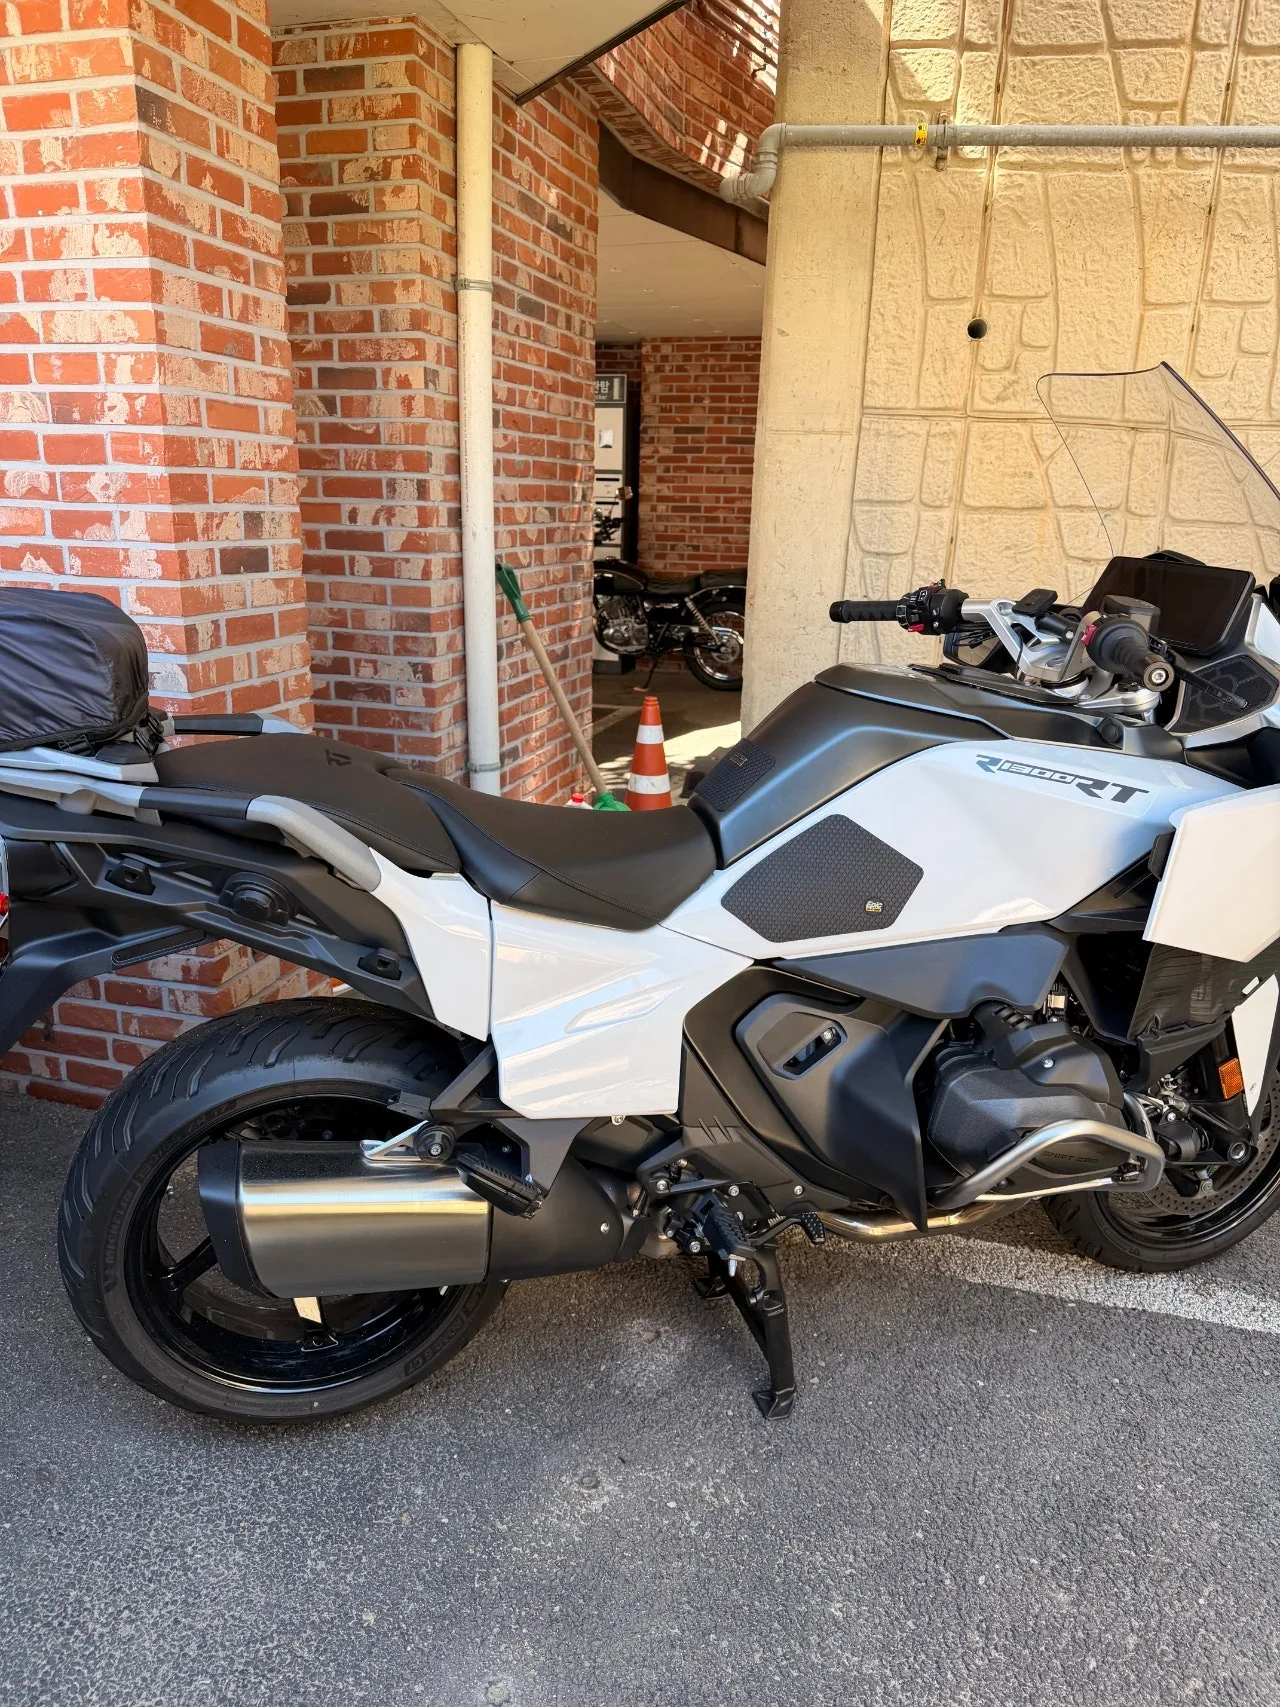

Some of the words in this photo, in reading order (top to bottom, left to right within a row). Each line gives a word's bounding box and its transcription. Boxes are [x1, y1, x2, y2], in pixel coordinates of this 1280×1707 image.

[1042, 1150, 1075, 1160] SHIFT
[1076, 1157, 1100, 1165] CAM
[104, 1189, 134, 1264] MICHELIN
